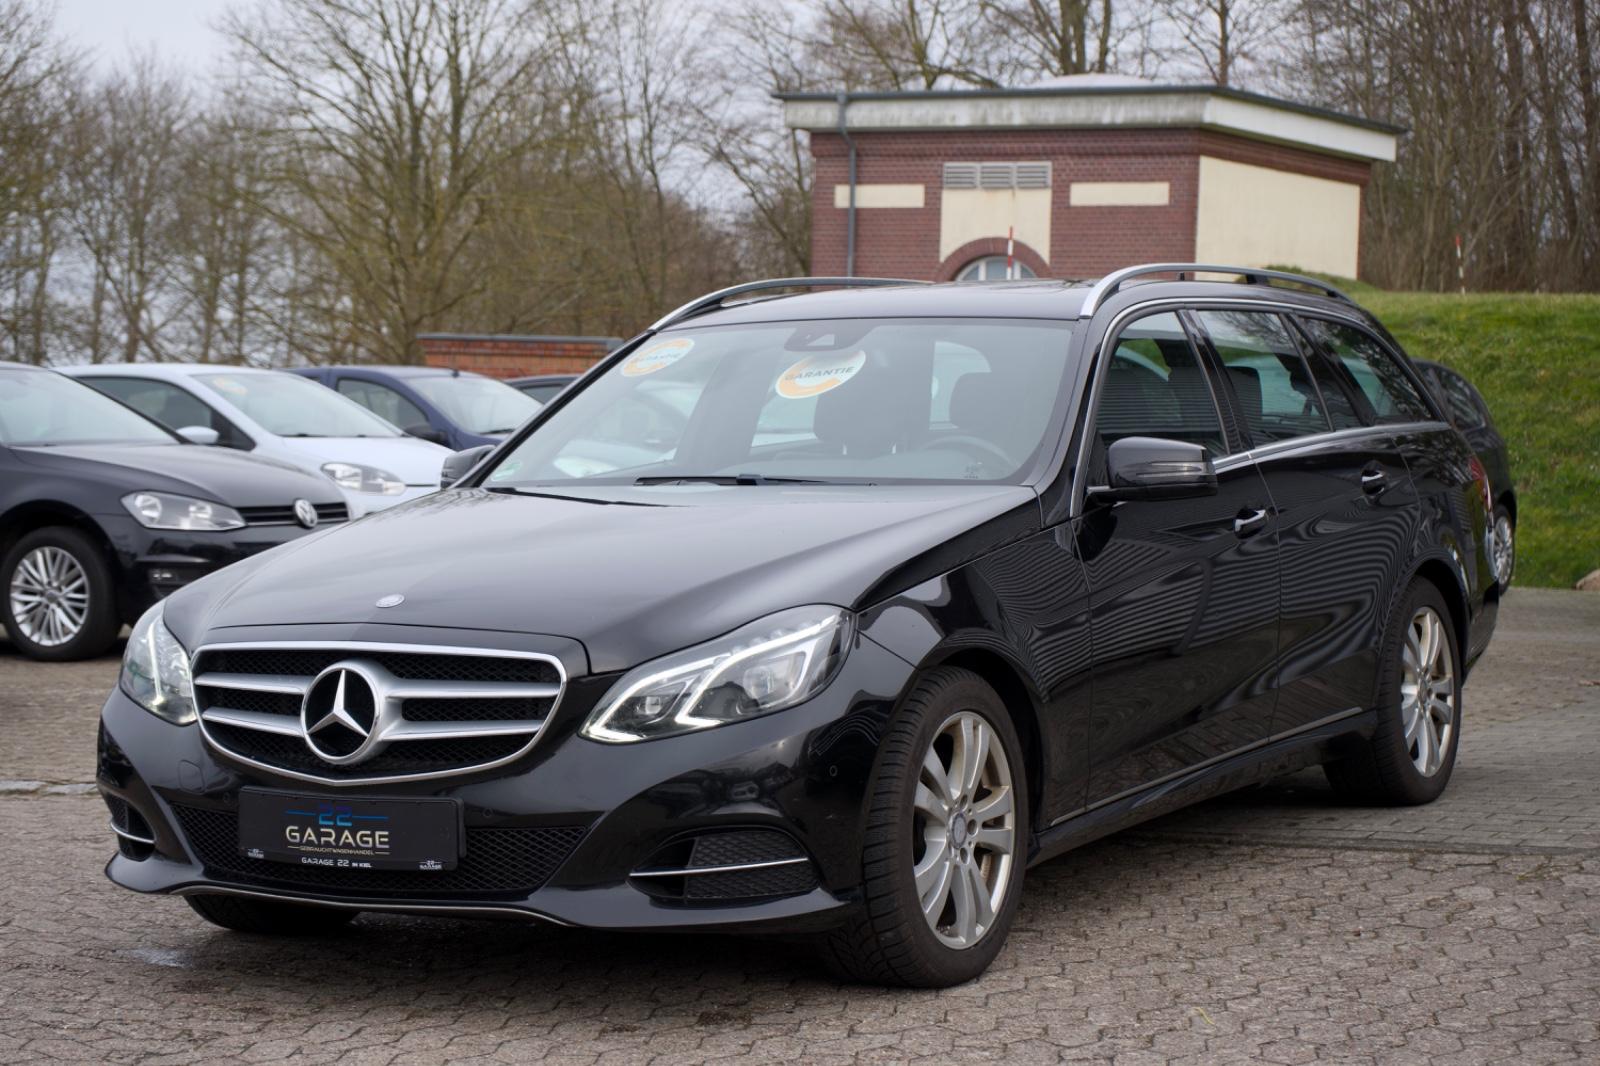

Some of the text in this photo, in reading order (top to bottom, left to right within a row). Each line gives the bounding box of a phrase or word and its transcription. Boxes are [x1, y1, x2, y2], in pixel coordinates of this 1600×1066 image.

[784, 366, 856, 381] GARANTIE
[318, 803, 353, 827] 22
[285, 825, 390, 848] GARAGE
[301, 857, 334, 866] GARAGE
[337, 859, 349, 867] 22
